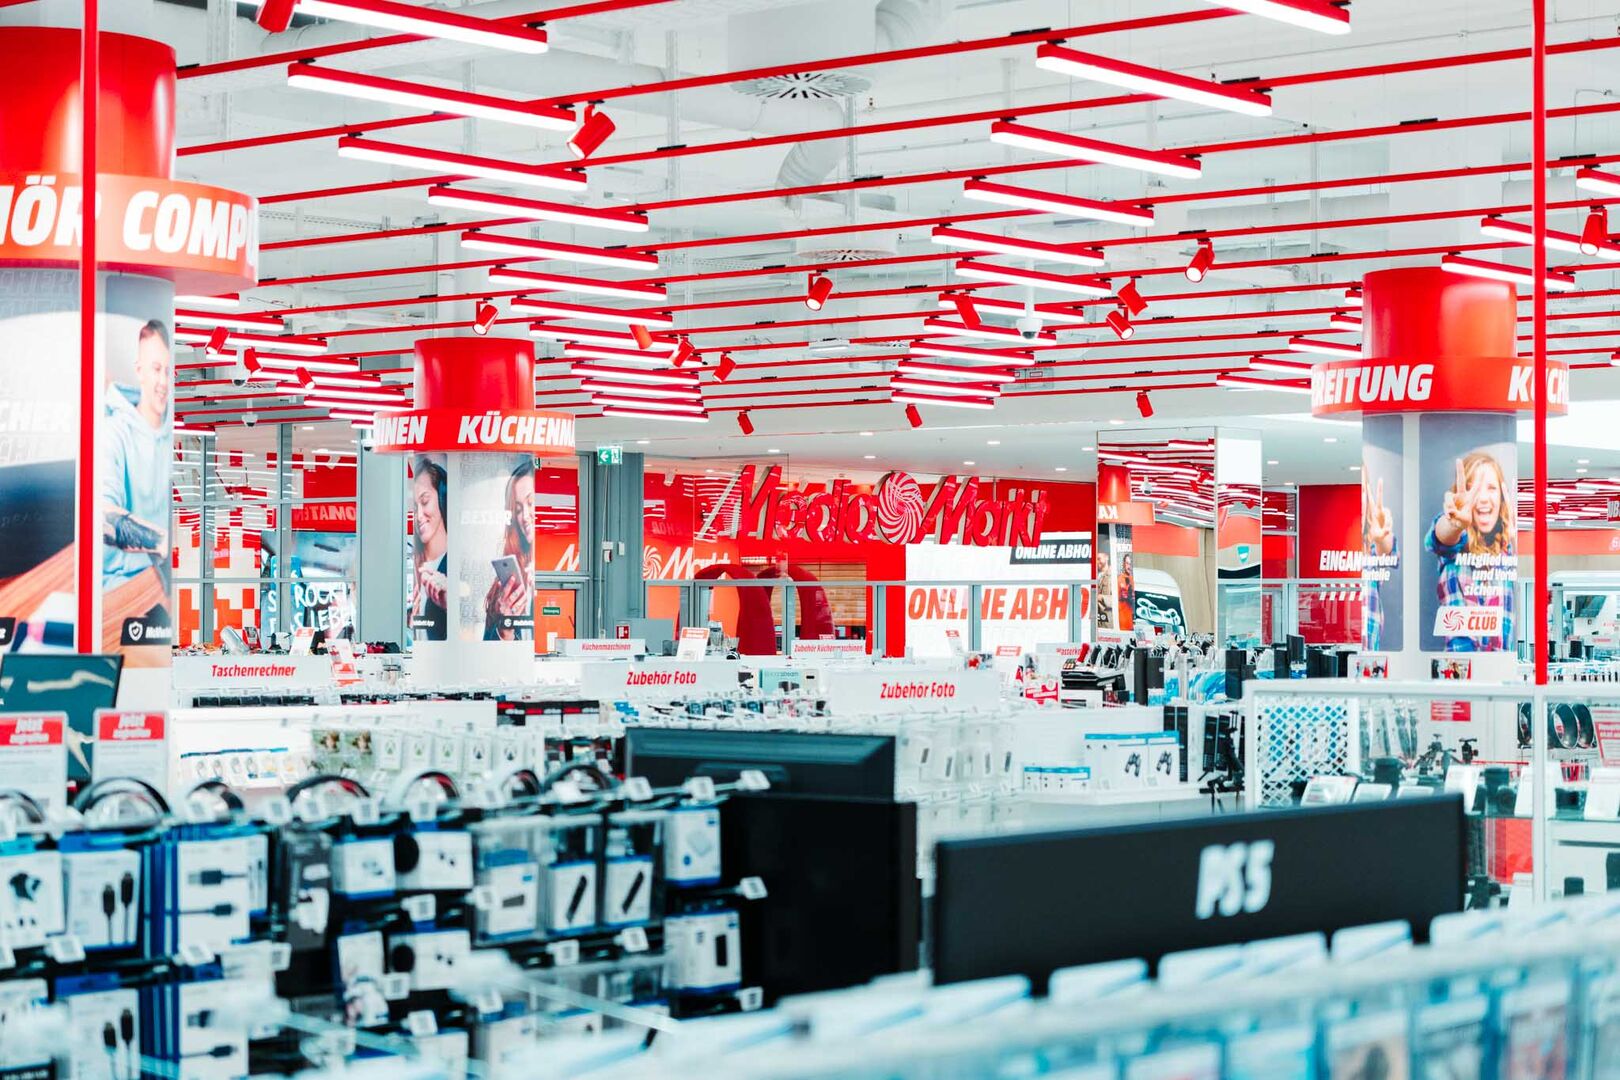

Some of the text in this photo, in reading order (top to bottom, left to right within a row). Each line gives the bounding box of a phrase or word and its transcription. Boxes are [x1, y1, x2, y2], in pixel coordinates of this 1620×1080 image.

[1508, 365, 1569, 403] KCH
[457, 411, 575, 447] KÜCHENM
[1455, 552, 1501, 568] Mitglied
[1472, 569, 1494, 581] und
[1467, 616, 1498, 631] CLUB
[211, 664, 297, 678] Taschenrechner
[626, 669, 698, 686] Zubehör Foto
[880, 682, 955, 700] Zubehör Foto
[1195, 838, 1275, 920] PS5
